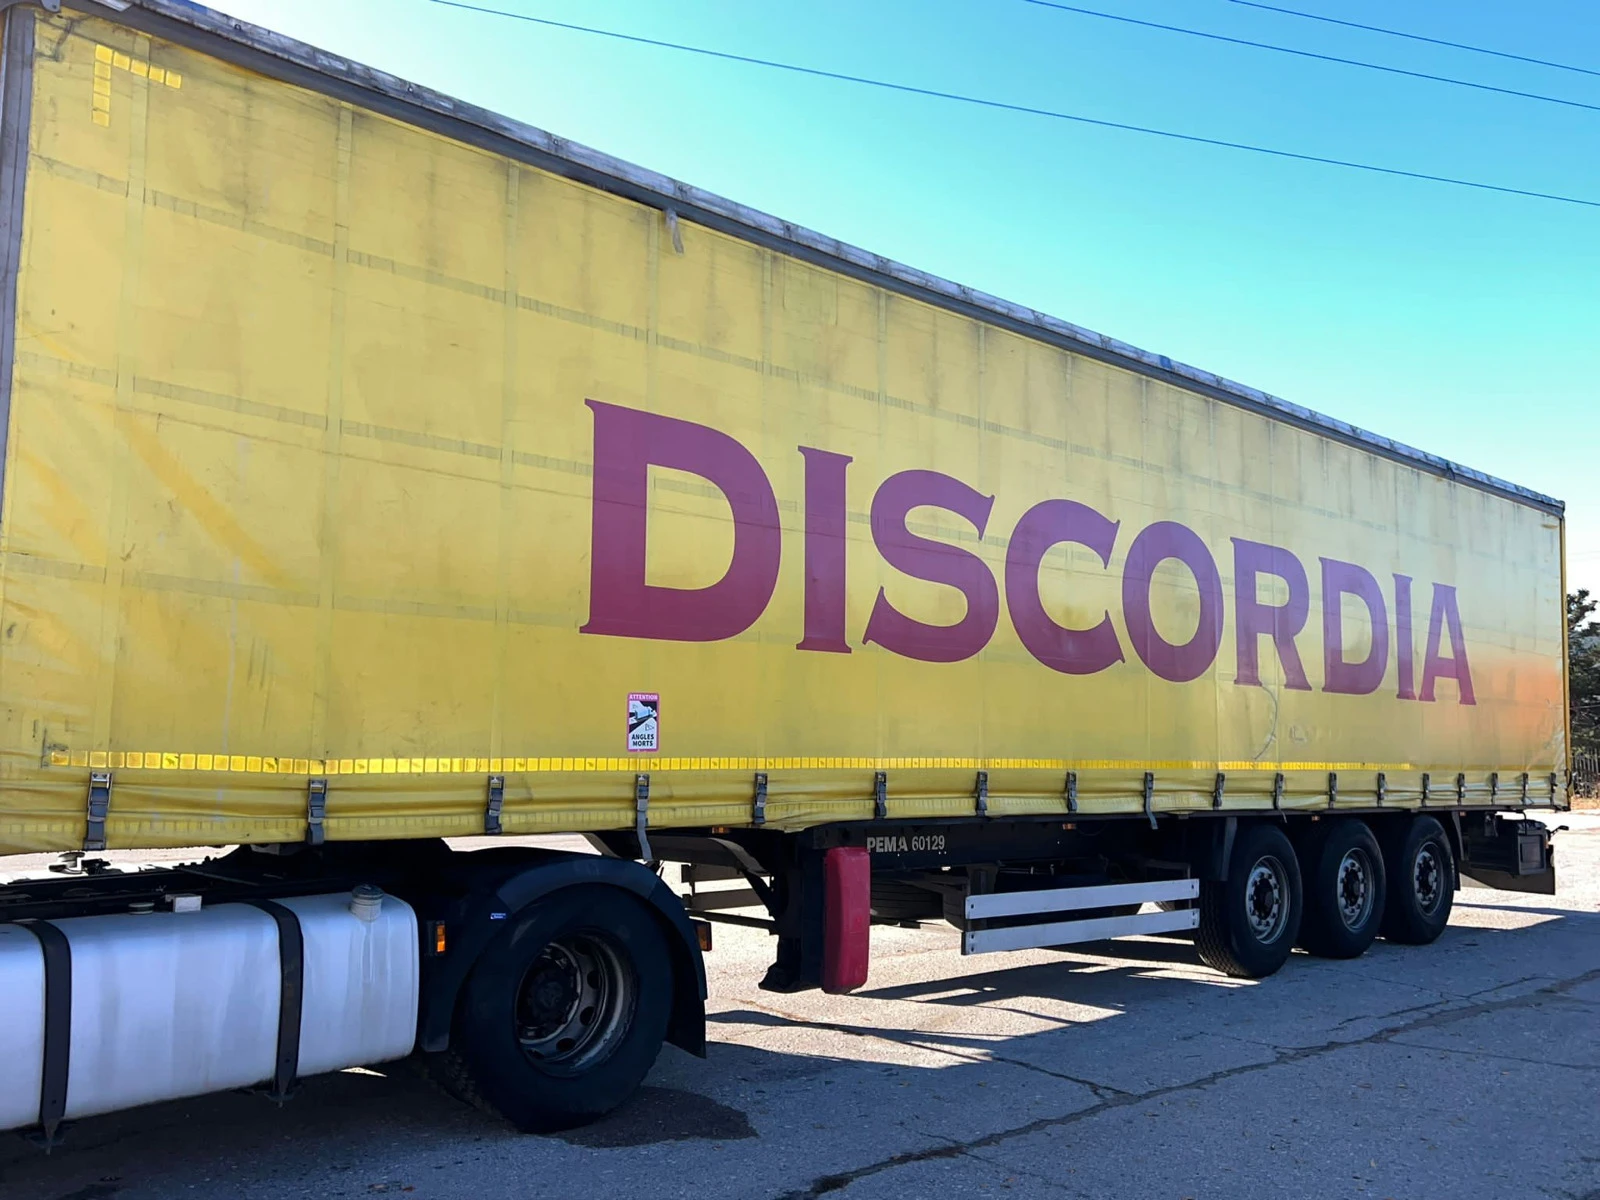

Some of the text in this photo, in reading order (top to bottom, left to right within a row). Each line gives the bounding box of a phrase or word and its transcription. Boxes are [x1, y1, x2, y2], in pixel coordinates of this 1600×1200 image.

[580, 398, 1476, 705] DISCORDIA
[866, 835, 945, 852] PEMA 60129
